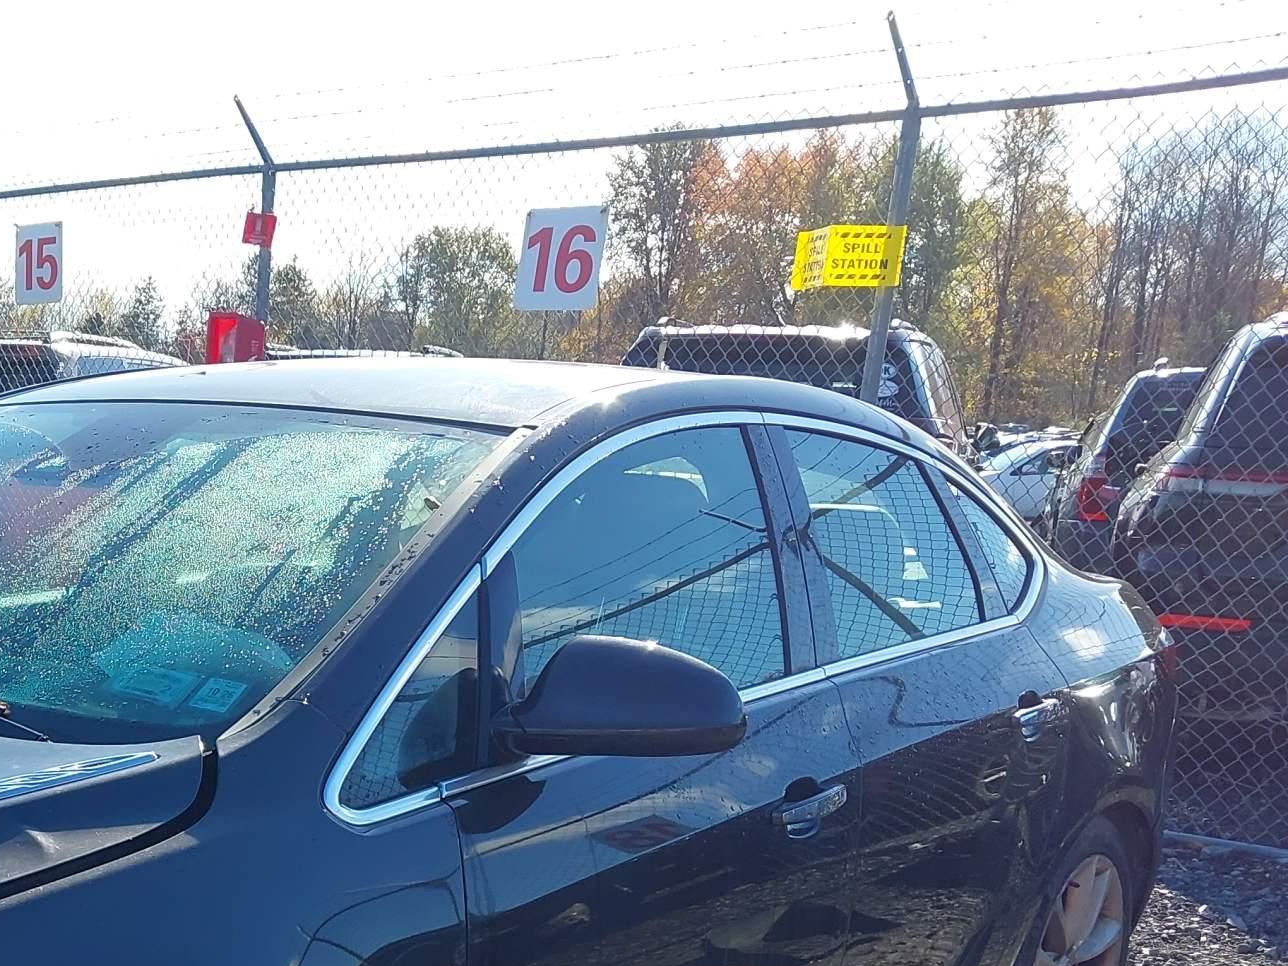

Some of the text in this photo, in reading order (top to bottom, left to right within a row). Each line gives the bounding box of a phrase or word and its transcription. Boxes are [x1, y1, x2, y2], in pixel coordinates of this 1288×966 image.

[18, 236, 58, 291] 15
[528, 224, 596, 294] 16
[831, 258, 889, 270] STATION
[842, 242, 881, 254] SPILL
